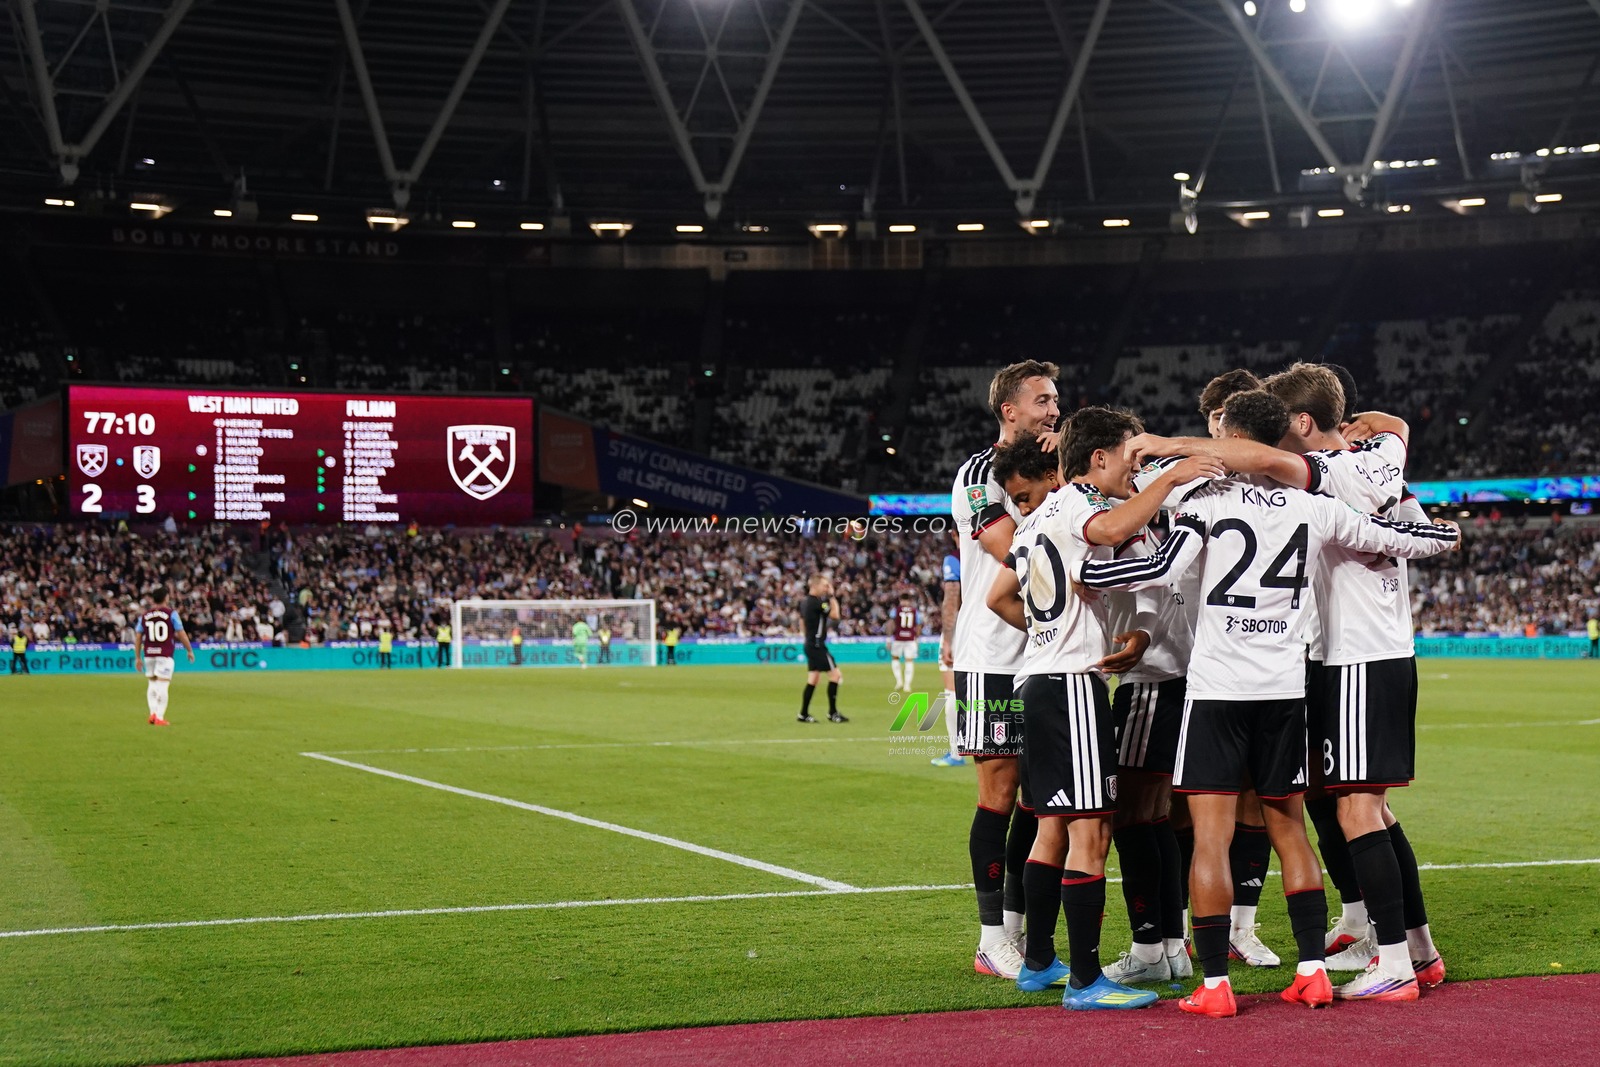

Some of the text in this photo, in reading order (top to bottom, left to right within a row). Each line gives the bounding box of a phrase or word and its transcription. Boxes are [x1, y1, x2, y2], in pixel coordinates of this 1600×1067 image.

[111, 228, 400, 257] BOBBY MOORE STAND
[84, 411, 155, 435] 77:10
[607, 439, 648, 465] STAY
[648, 451, 747, 493] CONNECTED
[616, 466, 635, 482] at
[81, 483, 103, 513] 2
[136, 484, 156, 514] 3
[1241, 487, 1287, 507] KING
[1206, 517, 1309, 609] 24
[145, 621, 168, 642] 10
[898, 612, 914, 629] 11
[1241, 619, 1288, 634] SBOTOP
[59, 654, 136, 670] Partner
[1322, 738, 1335, 776] 8
